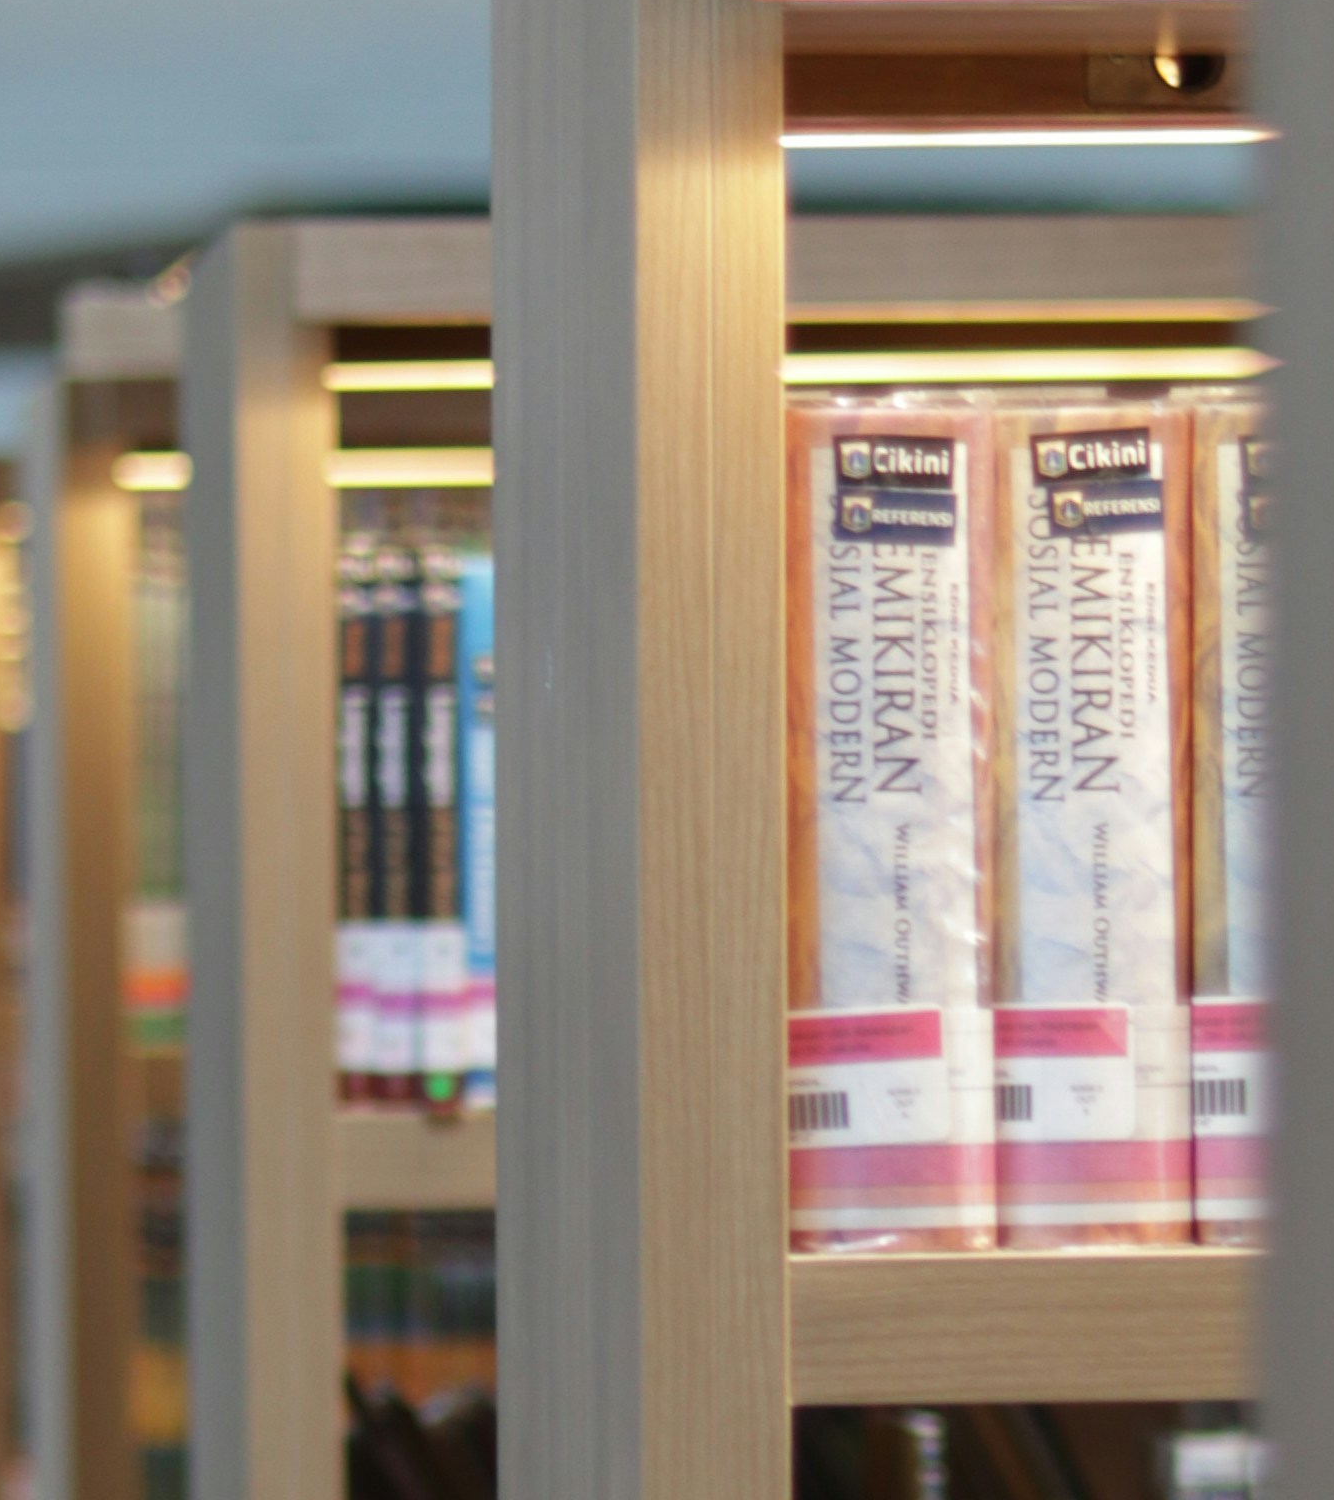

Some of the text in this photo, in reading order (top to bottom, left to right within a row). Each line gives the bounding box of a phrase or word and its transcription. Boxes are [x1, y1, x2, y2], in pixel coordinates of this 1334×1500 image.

[871, 508, 954, 529] REFERENSI
[873, 445, 950, 476] Cikini
[1068, 439, 1147, 471] Cikini
[1083, 497, 1161, 517] REFERENSI
[828, 634, 866, 804] MODERN
[872, 544, 923, 794] EMIKIRAN
[921, 552, 937, 741] ENSIKLOPEDI
[1028, 633, 1066, 803] MODERN
[1071, 536, 1121, 794] EMIKIRAN
[1118, 552, 1136, 739] ENSIKLOPEDI
[894, 822, 911, 1004] WILLIAM OUTHW
[1092, 821, 1111, 1003] WILLIAM OUTHW
